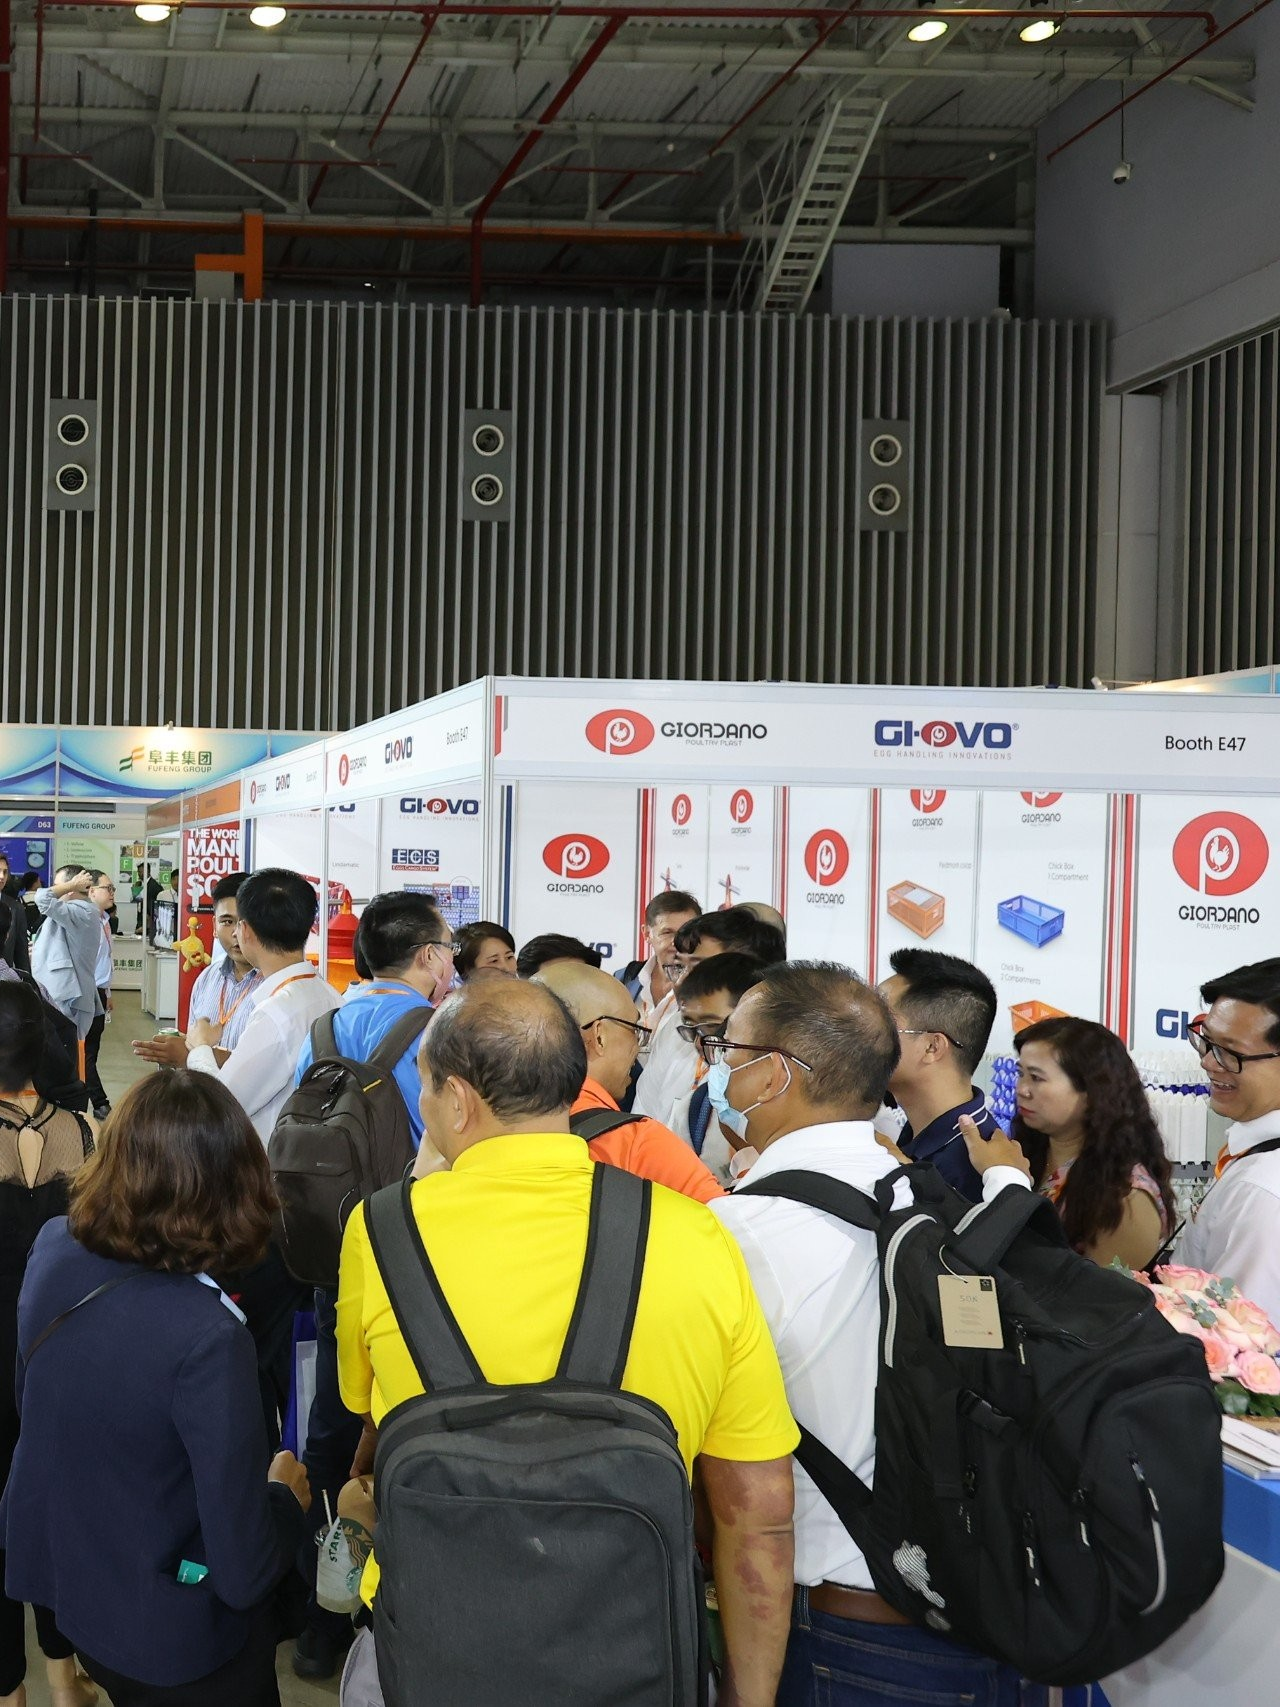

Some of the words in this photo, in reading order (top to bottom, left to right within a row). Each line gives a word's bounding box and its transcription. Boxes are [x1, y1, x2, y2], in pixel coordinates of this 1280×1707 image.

[661, 722, 768, 739] GIORDANO
[720, 739, 742, 747] PLAST
[1165, 735, 1213, 751] Booth
[1218, 737, 1247, 752] E47
[148, 749, 213, 766] 阜丰集团
[873, 750, 892, 758] EGG
[897, 751, 944, 759] HANDLING
[949, 752, 1012, 760] INNOVATIONS
[147, 764, 181, 773] FUFENG
[183, 765, 212, 773] GROUP
[1021, 813, 1061, 823] GIORDANO
[37, 820, 52, 829] D63
[62, 822, 90, 831] FUFENG
[92, 823, 116, 831] GROUP
[189, 828, 210, 838] THE
[397, 849, 437, 864] ECS
[547, 883, 604, 893] GIORDANO
[807, 892, 845, 905] GIORDANO
[1178, 905, 1260, 924] GIORDANO
